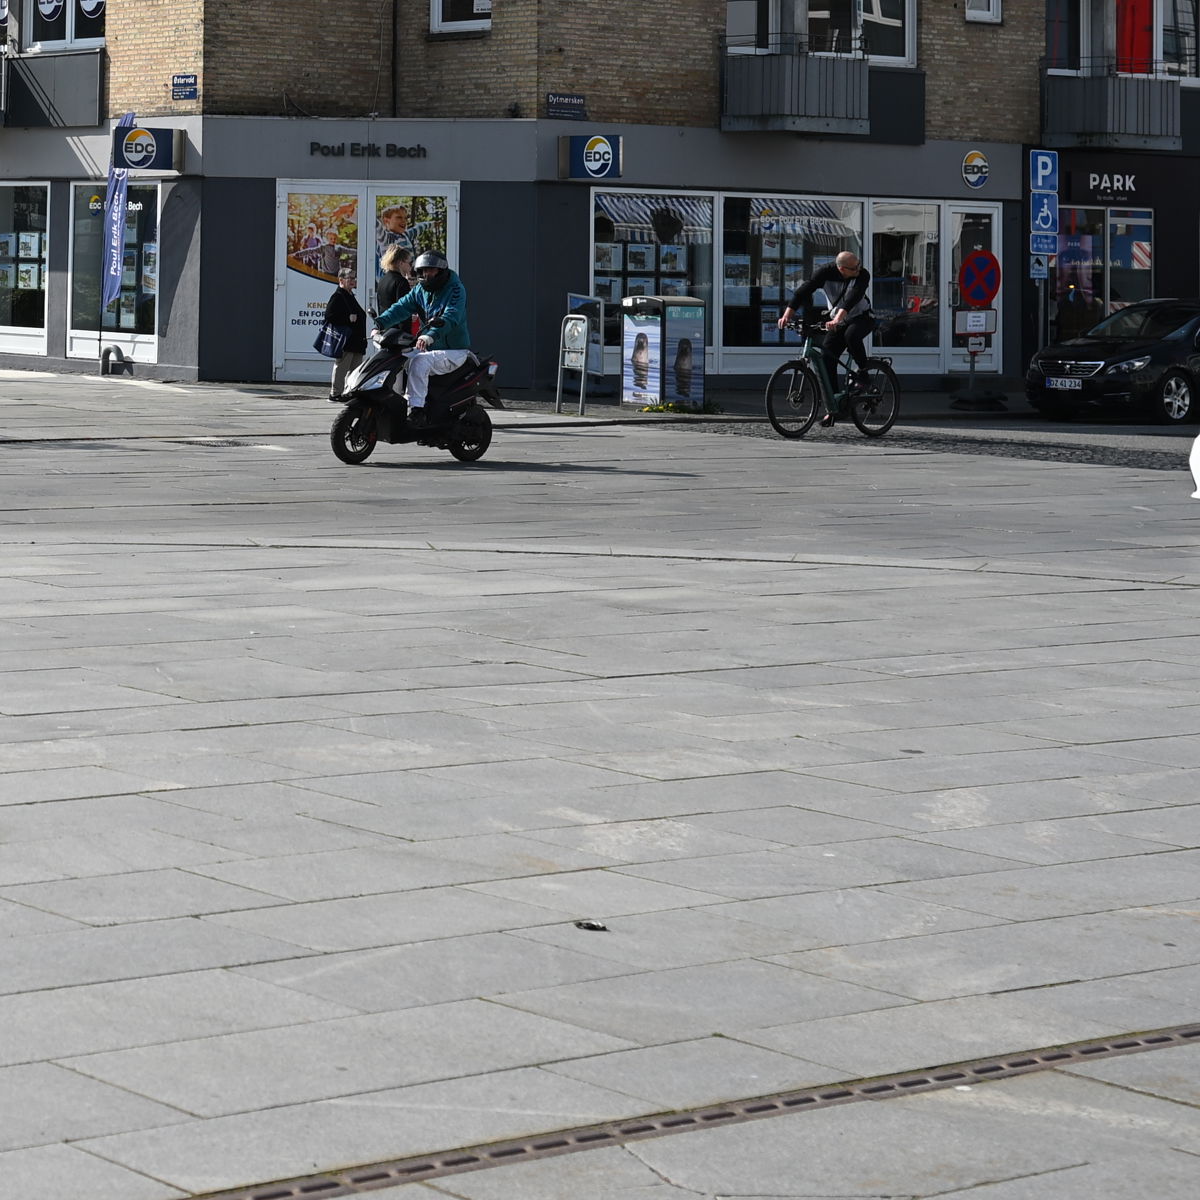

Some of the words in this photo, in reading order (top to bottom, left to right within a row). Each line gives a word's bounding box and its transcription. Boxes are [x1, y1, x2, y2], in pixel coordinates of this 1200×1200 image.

[124, 142, 155, 154] EDC
[310, 141, 345, 157] Poul
[350, 142, 381, 158] Erik
[386, 143, 427, 159] Bech
[584, 151, 611, 163] EDC
[964, 164, 989, 175] EDC
[1037, 155, 1053, 186] P
[1089, 173, 1136, 192] PARK
[111, 191, 119, 221] Bech
[128, 201, 143, 211] Bech
[109, 248, 118, 276] Poul
